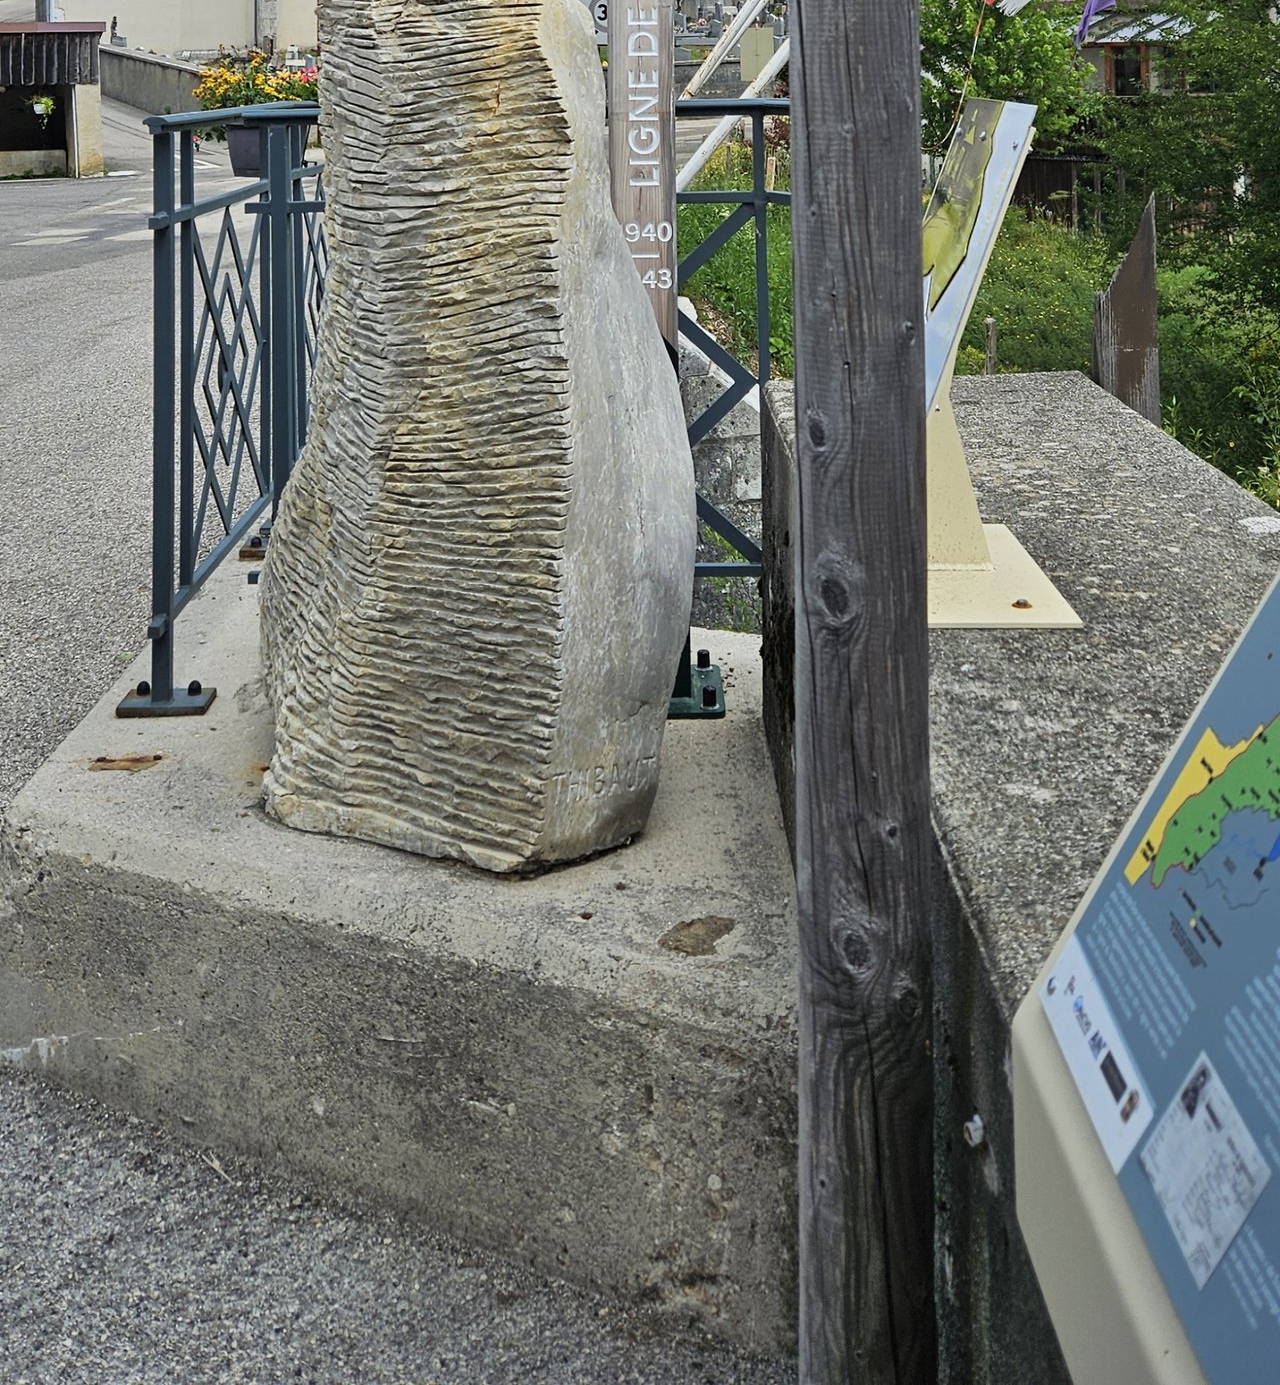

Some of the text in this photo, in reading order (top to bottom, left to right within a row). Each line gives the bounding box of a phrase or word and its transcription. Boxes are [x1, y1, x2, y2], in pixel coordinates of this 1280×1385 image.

[597, 3, 608, 22] 3
[627, 5, 659, 57] DE
[627, 68, 660, 186] LIGNE
[625, 221, 673, 243] 940
[642, 268, 673, 289] 43
